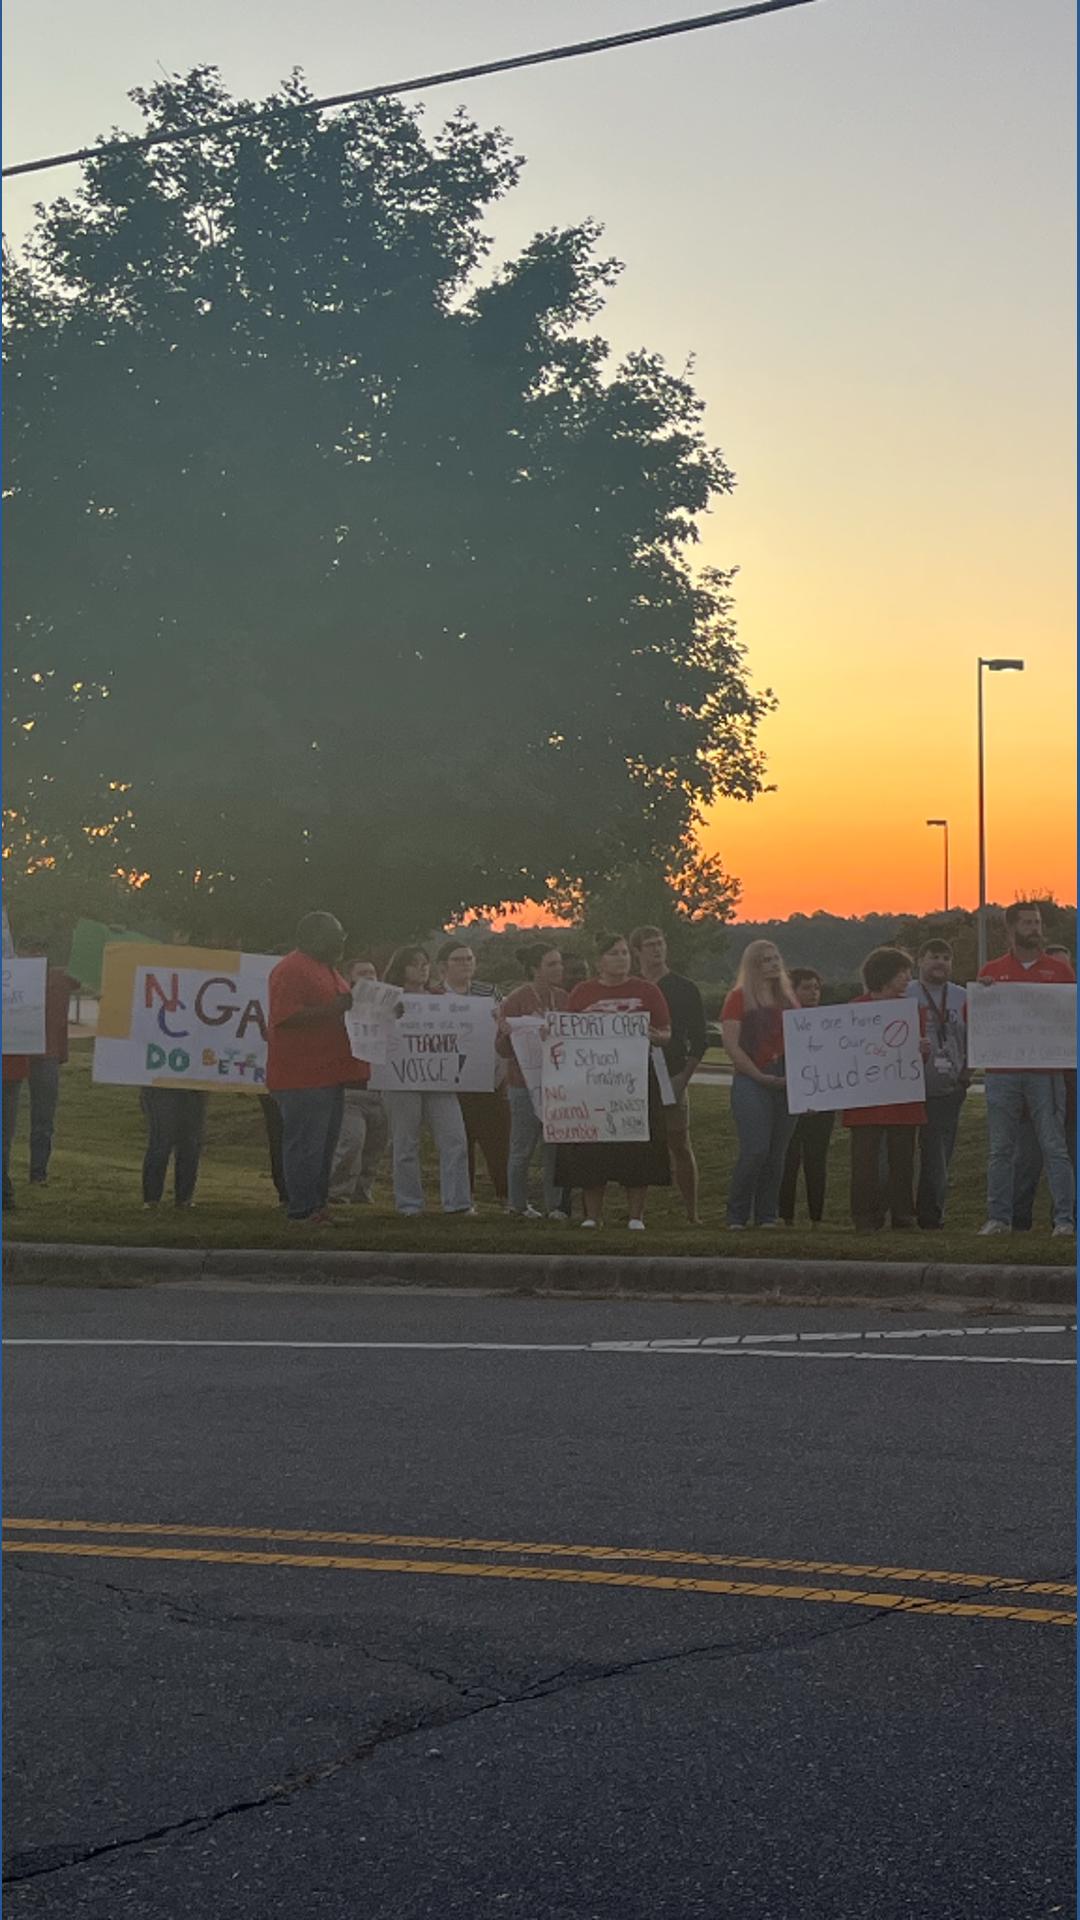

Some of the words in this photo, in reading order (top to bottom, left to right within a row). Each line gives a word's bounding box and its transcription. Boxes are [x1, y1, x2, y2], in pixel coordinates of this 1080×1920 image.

[546, 1013, 605, 1038] REPORT
[611, 1014, 648, 1037] CARD
[793, 1016, 812, 1032] We
[820, 1018, 843, 1031] are
[401, 1033, 459, 1054] TEACHER
[145, 1042, 190, 1072] DO
[202, 1047, 265, 1083] BETTER
[574, 1048, 619, 1067] School
[586, 1068, 637, 1095] Funding
[544, 1085, 567, 1101] NC
